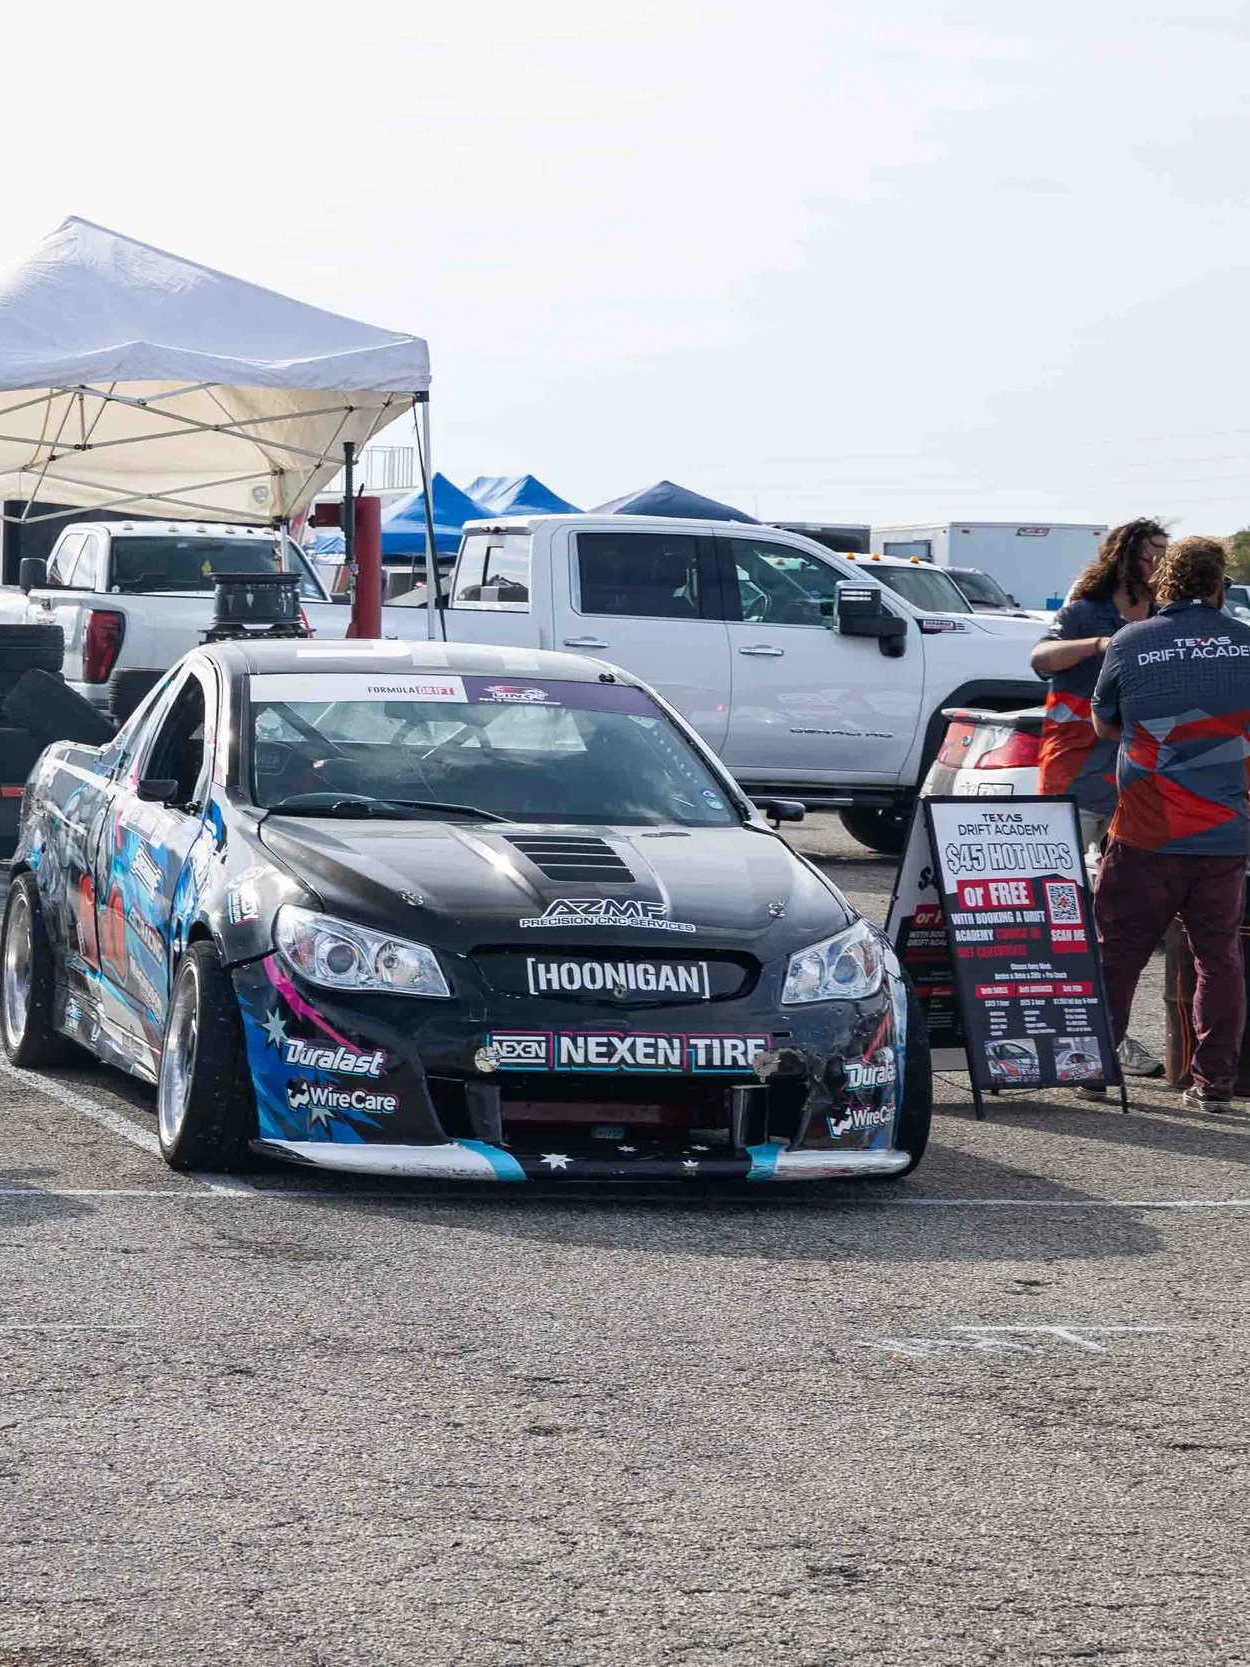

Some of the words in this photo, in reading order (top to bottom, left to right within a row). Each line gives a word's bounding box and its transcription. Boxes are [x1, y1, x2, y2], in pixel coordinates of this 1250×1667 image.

[1174, 636, 1232, 647] TEXAS
[1138, 648, 1186, 666] DRIFT
[1190, 645, 1250, 660] ACADE
[367, 686, 415, 694] FORMULA
[982, 813, 1023, 823] TEXAS
[958, 824, 994, 836] DRIFT
[995, 824, 1049, 836] ACADEMY
[946, 842, 985, 874] $45
[987, 842, 1026, 870] HOT
[1028, 842, 1074, 870] LAPS
[964, 887, 985, 907] or
[988, 881, 1031, 906] FREE
[542, 898, 668, 918] AZMF
[951, 913, 975, 925] WITH
[975, 911, 1014, 924] BOOKING
[1016, 911, 1023, 923] A
[1024, 910, 1046, 923] DRIFT
[520, 916, 596, 928] PRECISION
[598, 916, 628, 926] CNC
[629, 917, 696, 933] SERVICES
[955, 928, 994, 942] ACADEMY
[1051, 929, 1069, 941] SCAN
[1072, 929, 1086, 941] ME
[285, 1039, 385, 1074] Duralast
[492, 1040, 547, 1058] NEXEN
[559, 1035, 682, 1067] NEXEN
[689, 1037, 766, 1067] TIRE
[843, 1062, 896, 1088] Durala
[309, 1086, 397, 1111] WireCare
[852, 1105, 896, 1127] WireCa
